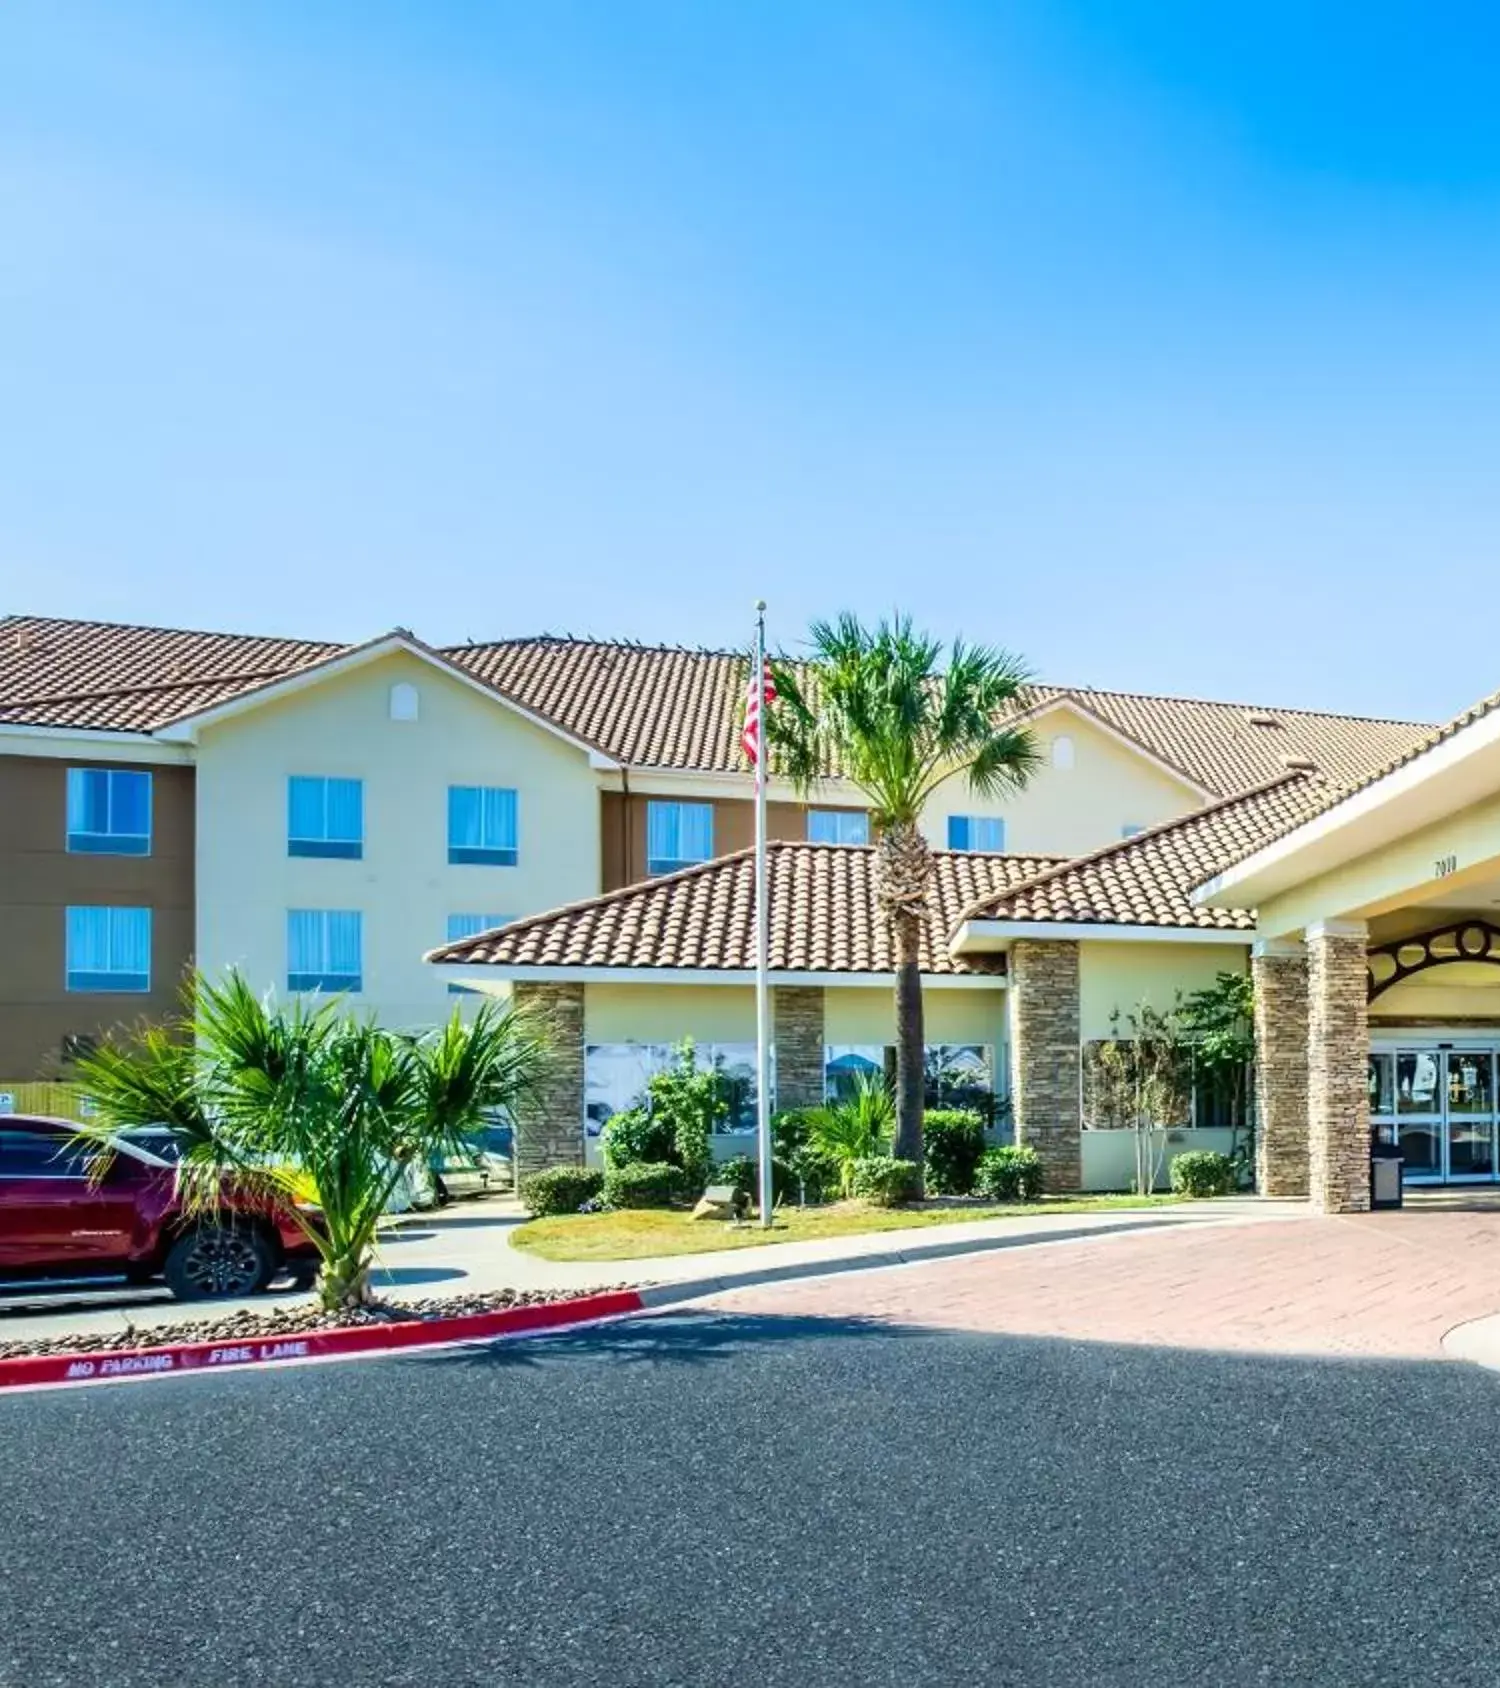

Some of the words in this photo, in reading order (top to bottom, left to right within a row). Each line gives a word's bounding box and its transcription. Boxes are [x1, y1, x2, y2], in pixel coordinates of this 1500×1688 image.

[67, 1361, 95, 1377] NO
[100, 1354, 173, 1373] PARKING
[208, 1347, 252, 1363] FIRE
[260, 1341, 309, 1359] LANE
